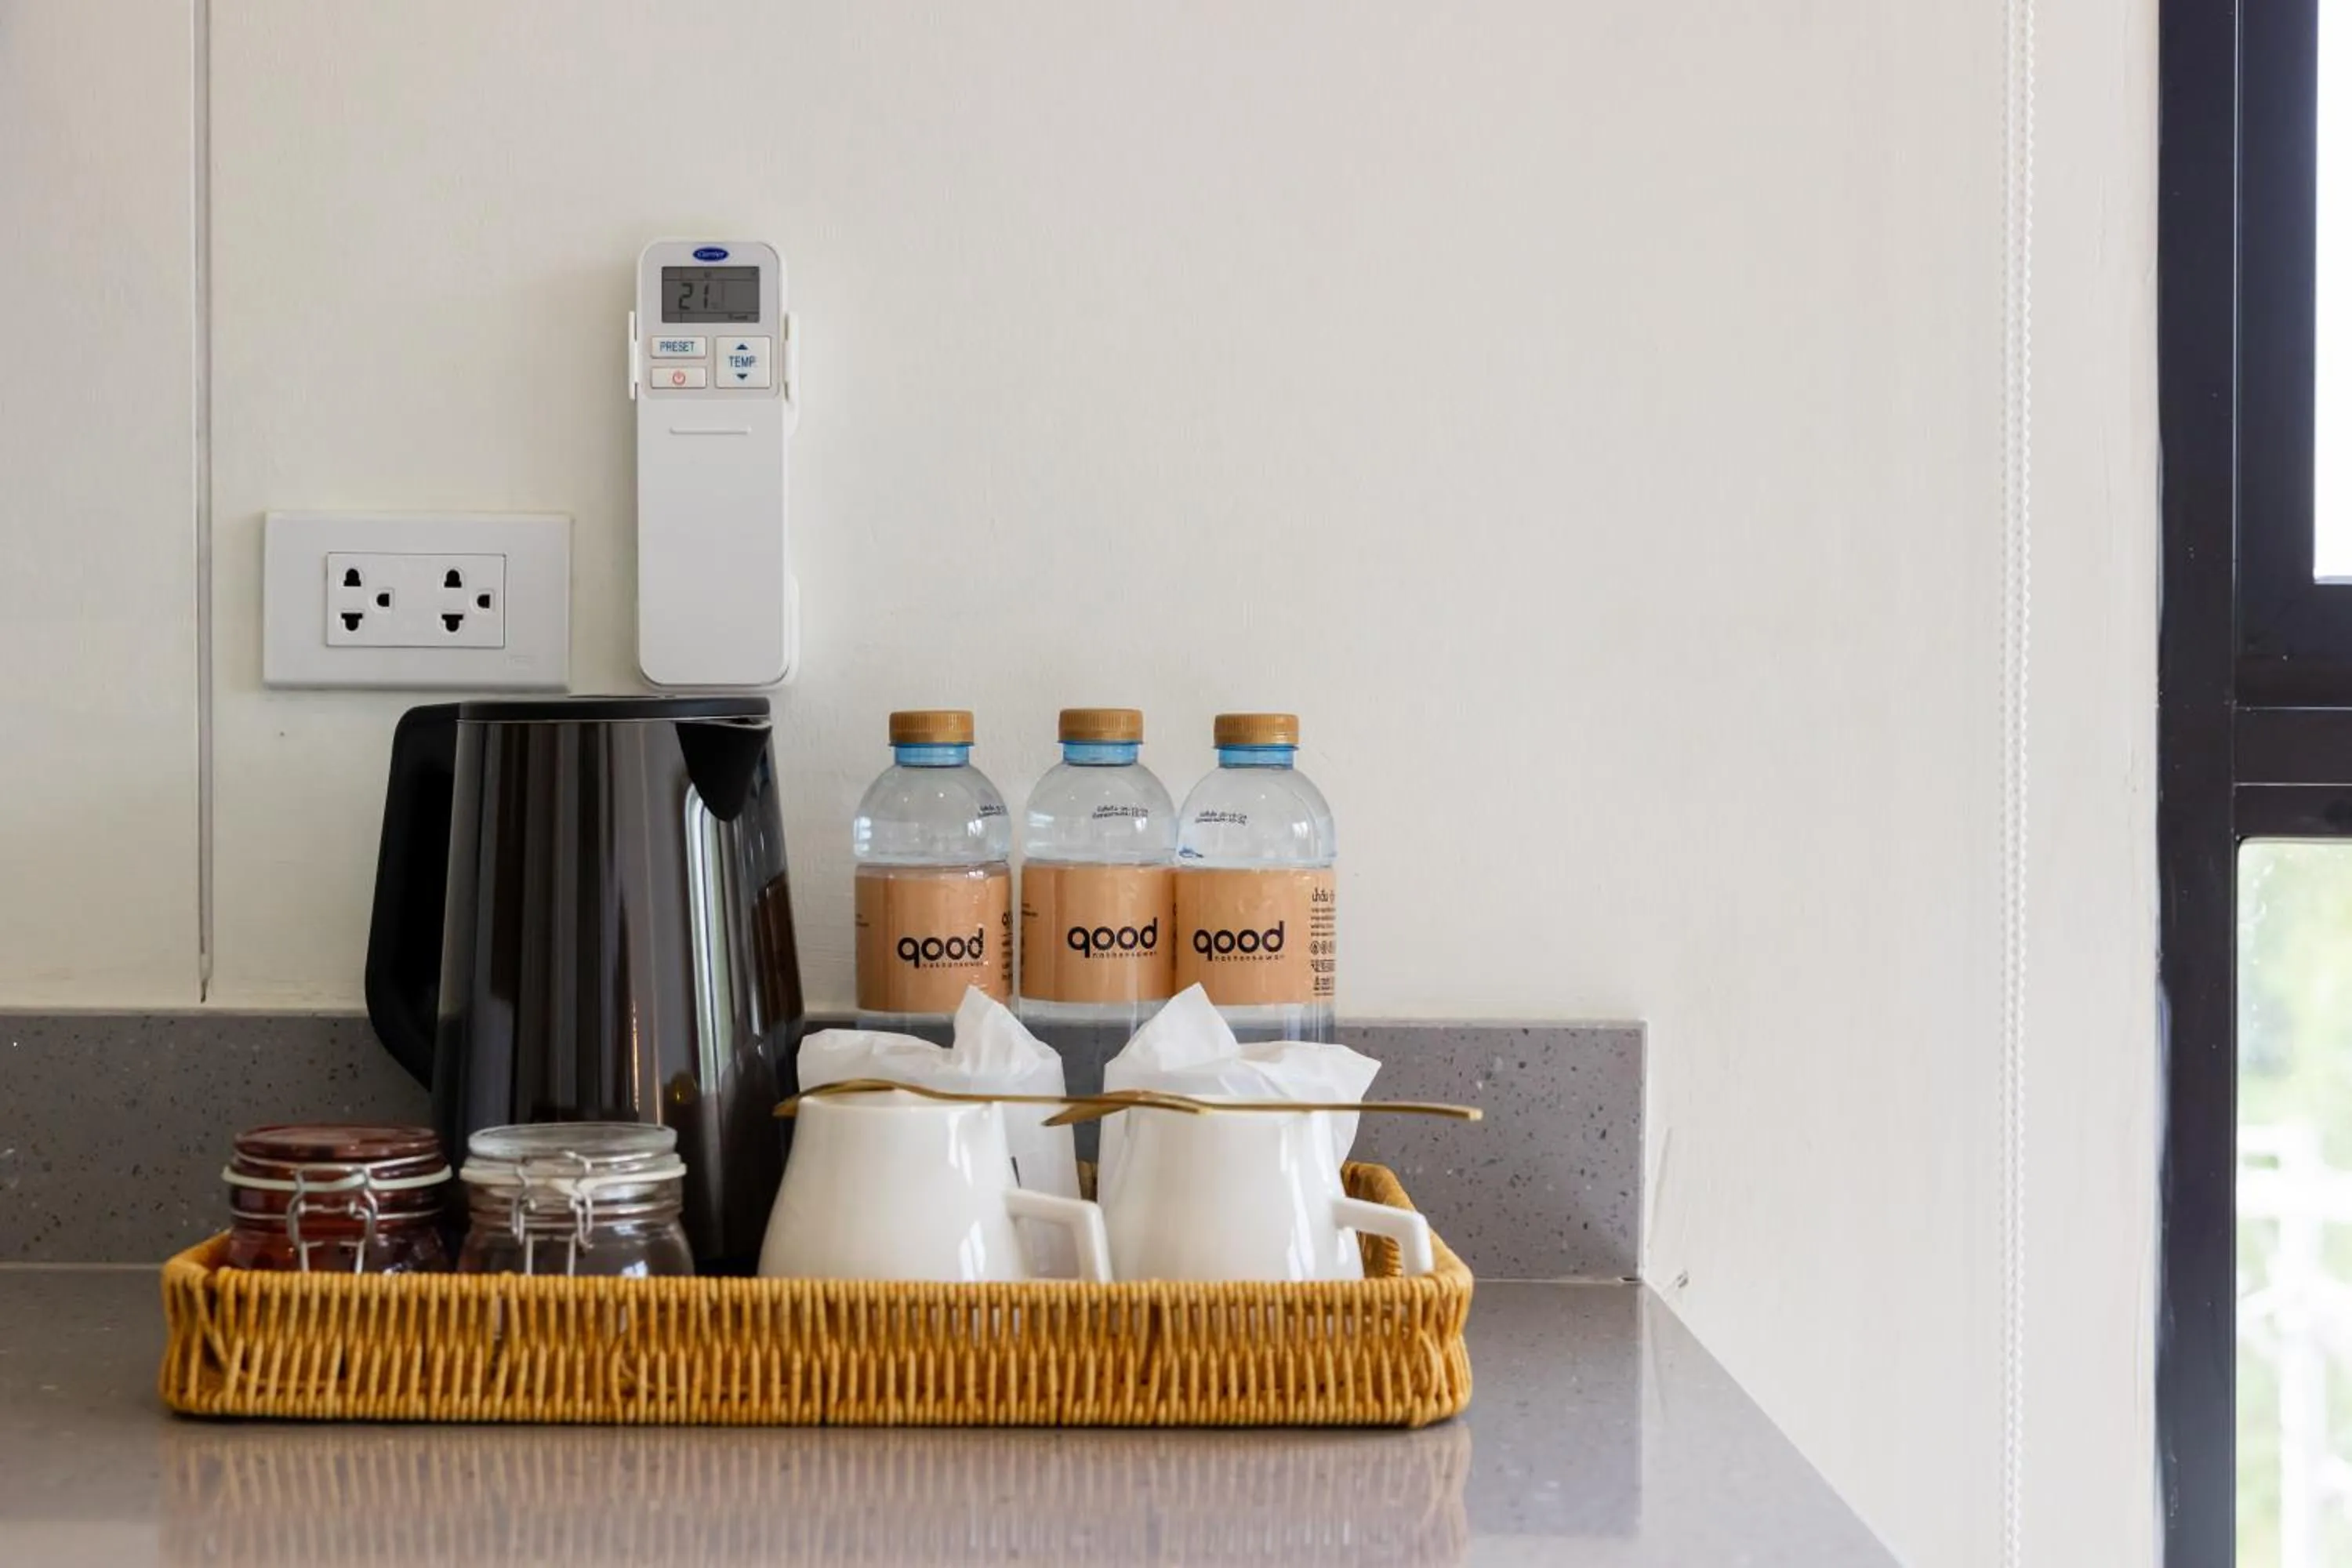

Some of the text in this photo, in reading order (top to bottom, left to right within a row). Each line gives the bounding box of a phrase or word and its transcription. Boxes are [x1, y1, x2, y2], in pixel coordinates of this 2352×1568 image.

[678, 283, 709, 310] 21
[660, 341, 695, 352] PRESET
[729, 356, 756, 368] TEMP
[898, 927, 984, 968] qood
[1067, 917, 1158, 958] qood
[1192, 920, 1284, 961] qood
